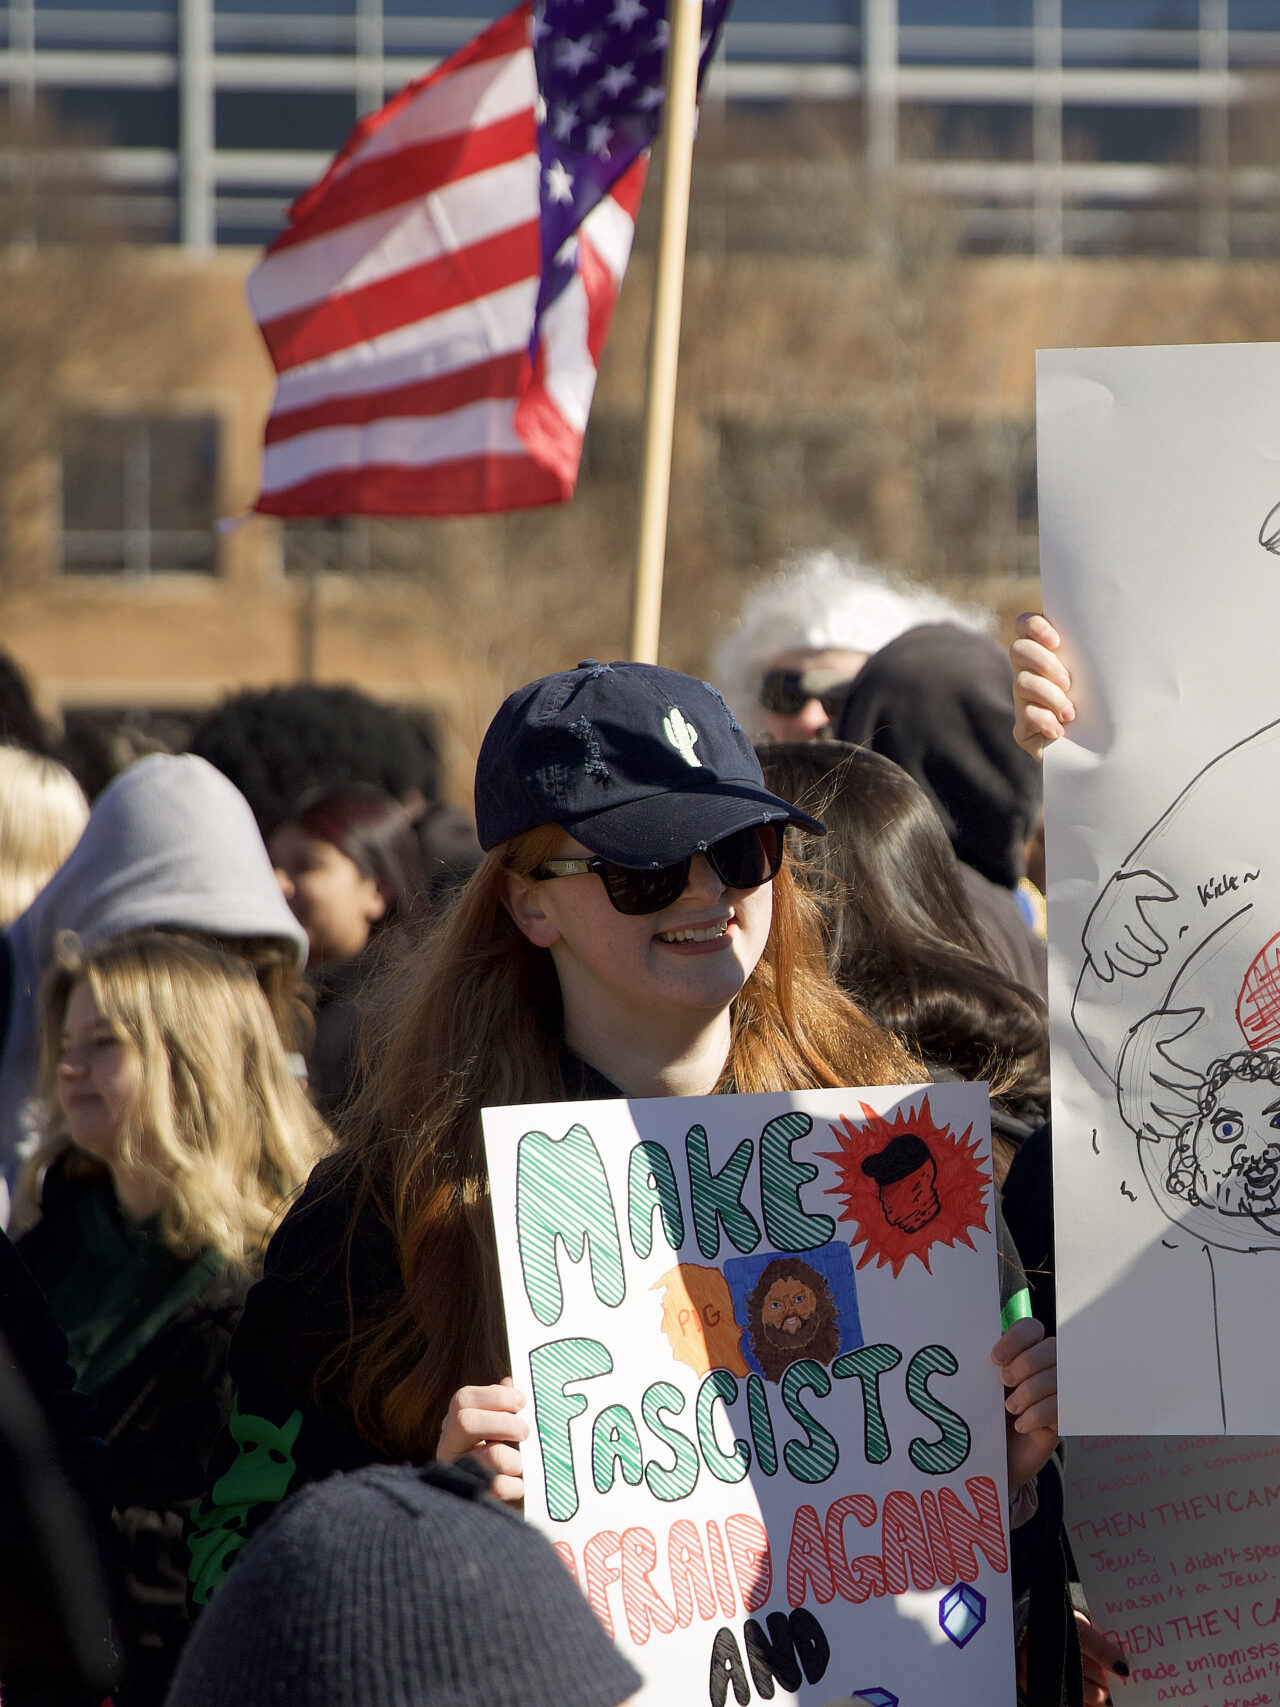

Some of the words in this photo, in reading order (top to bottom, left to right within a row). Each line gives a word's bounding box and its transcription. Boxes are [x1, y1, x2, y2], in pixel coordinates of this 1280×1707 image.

[516, 1111, 836, 1327] MAKE
[677, 1303, 721, 1337] PIG
[528, 1337, 972, 1523] FASCISTS
[1114, 1447, 1153, 1466] and
[1097, 1465, 1172, 1494] wasn't
[1180, 1463, 1197, 1476] a
[1070, 1510, 1147, 1542] THEN
[553, 1513, 772, 1646] FRAID
[786, 1476, 1009, 1608] AGAIN
[1088, 1547, 1157, 1573] Jews,
[1126, 1567, 1162, 1591] and
[1184, 1546, 1241, 1575] didn't
[1104, 1583, 1188, 1615] wasn't
[1195, 1580, 1212, 1595] a
[1218, 1570, 1277, 1590] Jew.
[1165, 1605, 1241, 1642] THEY
[709, 1607, 831, 1707] AND
[1157, 1677, 1199, 1702] and
